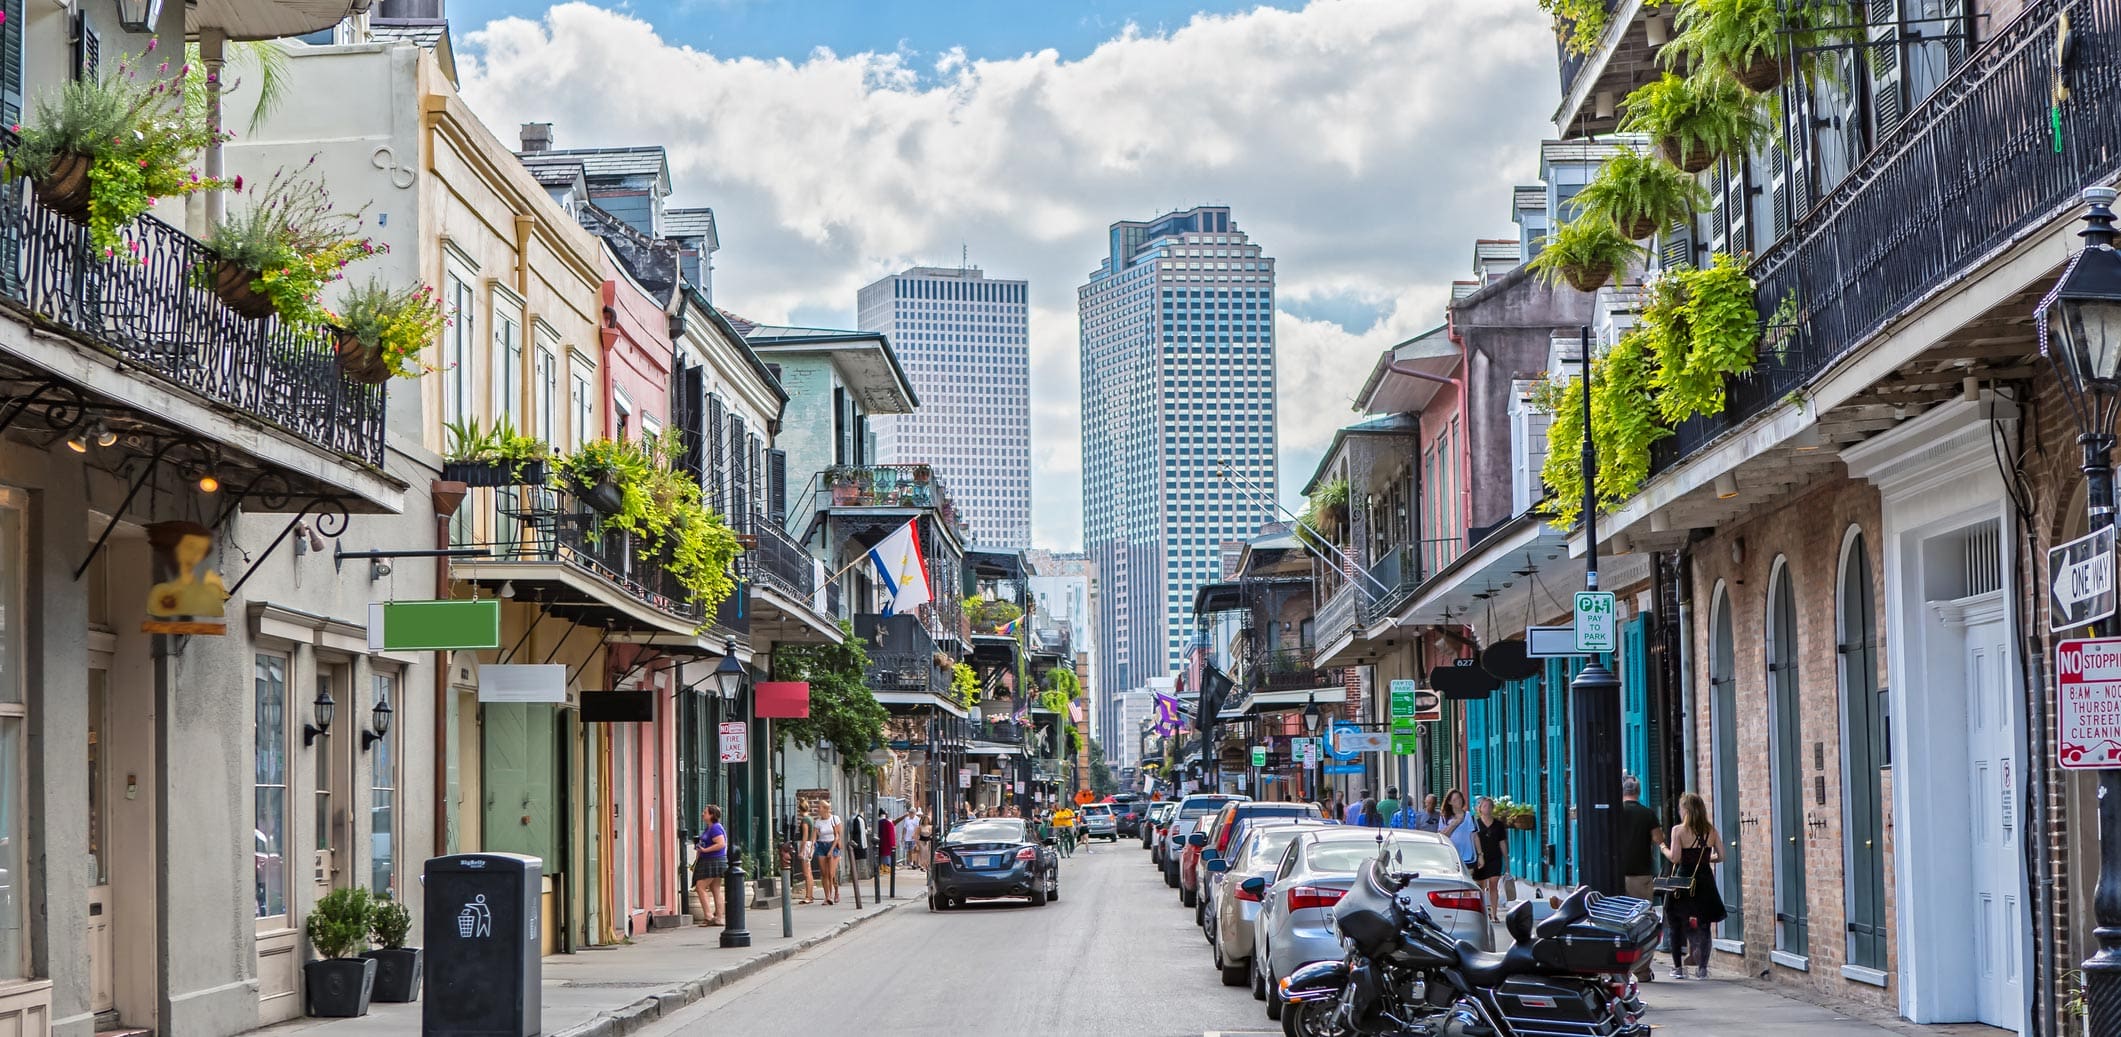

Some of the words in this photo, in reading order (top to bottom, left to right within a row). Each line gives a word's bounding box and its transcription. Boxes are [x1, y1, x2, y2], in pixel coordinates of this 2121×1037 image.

[2071, 564, 2090, 598] ONE
[2092, 555, 2109, 592] WAY
[1456, 659, 1474, 667] 627
[2060, 650, 2082, 675] NO
[2073, 701, 2121, 714] THURSDA
[2079, 713, 2121, 726] STREET
[720, 725, 729, 733] NO
[2071, 727, 2121, 739] CLEANIN
[726, 735, 739, 743] FIRE
